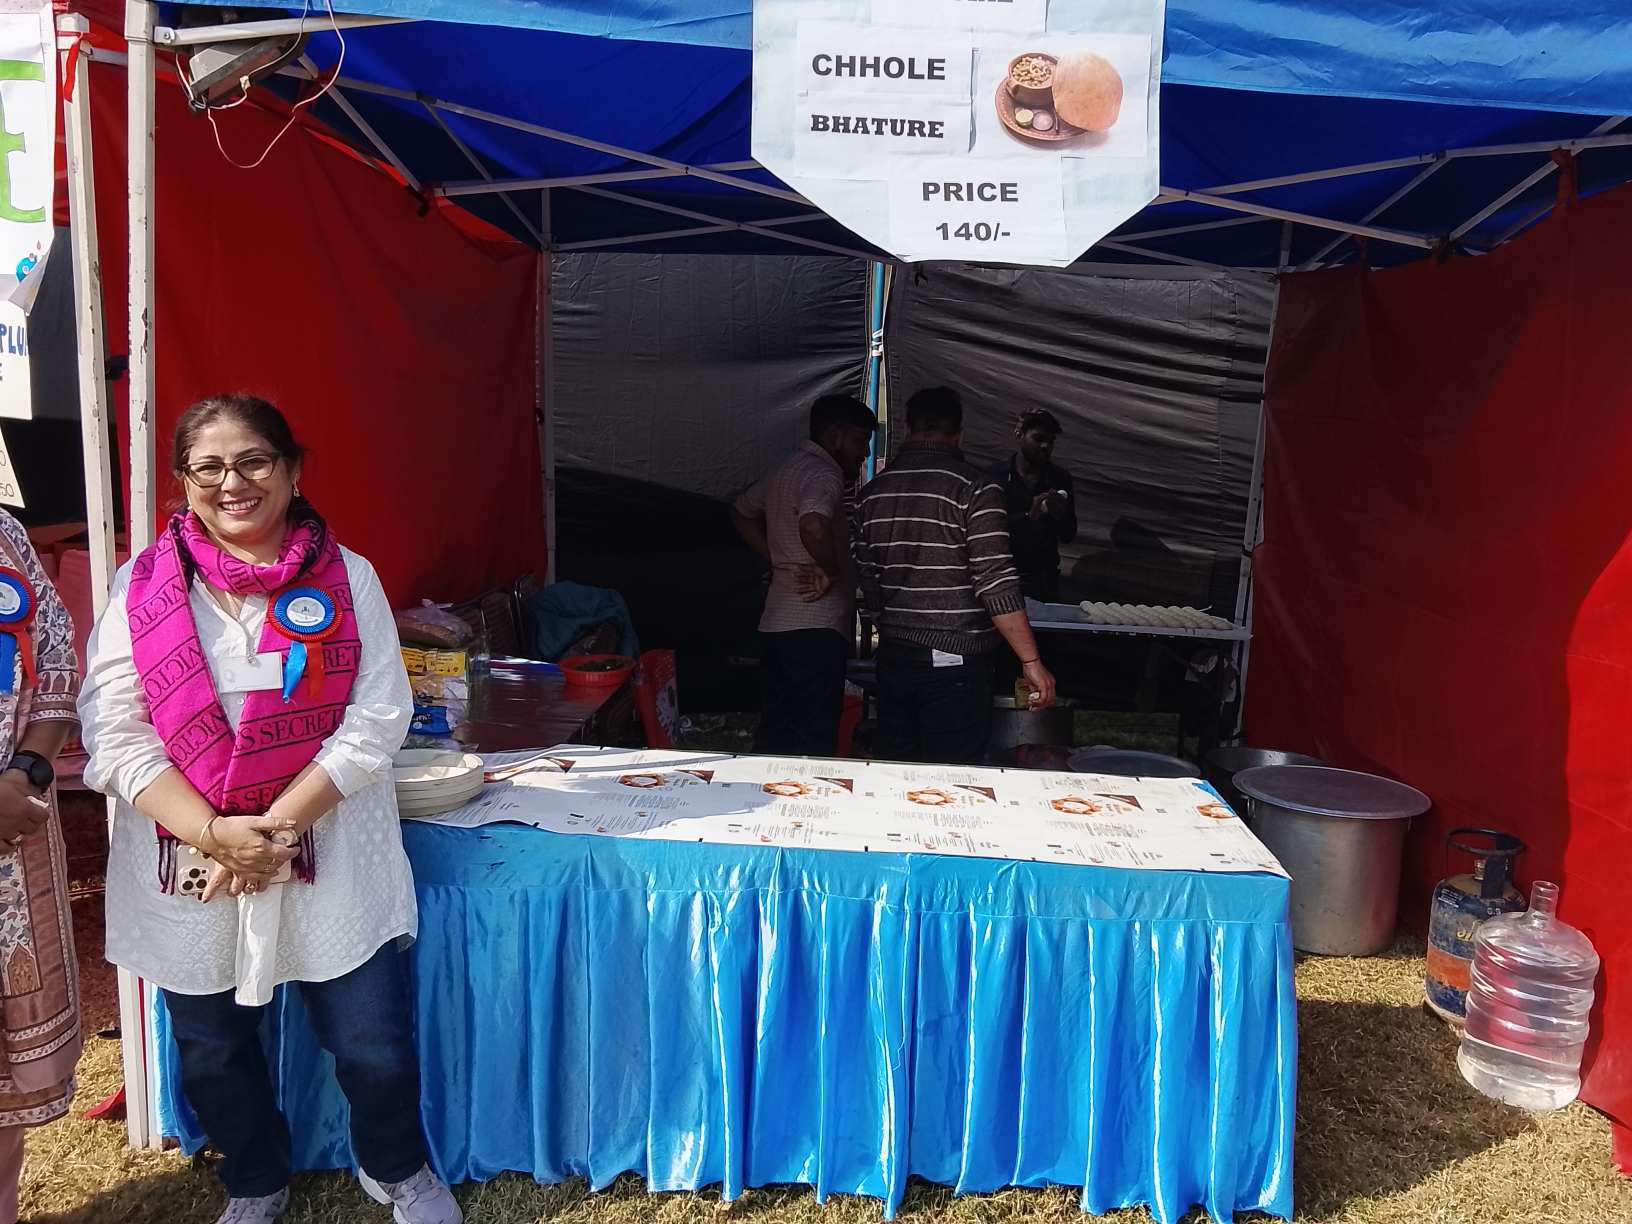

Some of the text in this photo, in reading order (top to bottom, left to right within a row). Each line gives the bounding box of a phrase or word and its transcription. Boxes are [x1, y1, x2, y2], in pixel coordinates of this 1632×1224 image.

[811, 53, 946, 81] CHHOLE
[810, 114, 945, 139] BHATURE
[922, 182, 1018, 202] PRICE
[936, 222, 1011, 242] 140/-
[260, 709, 339, 745] SECRET
